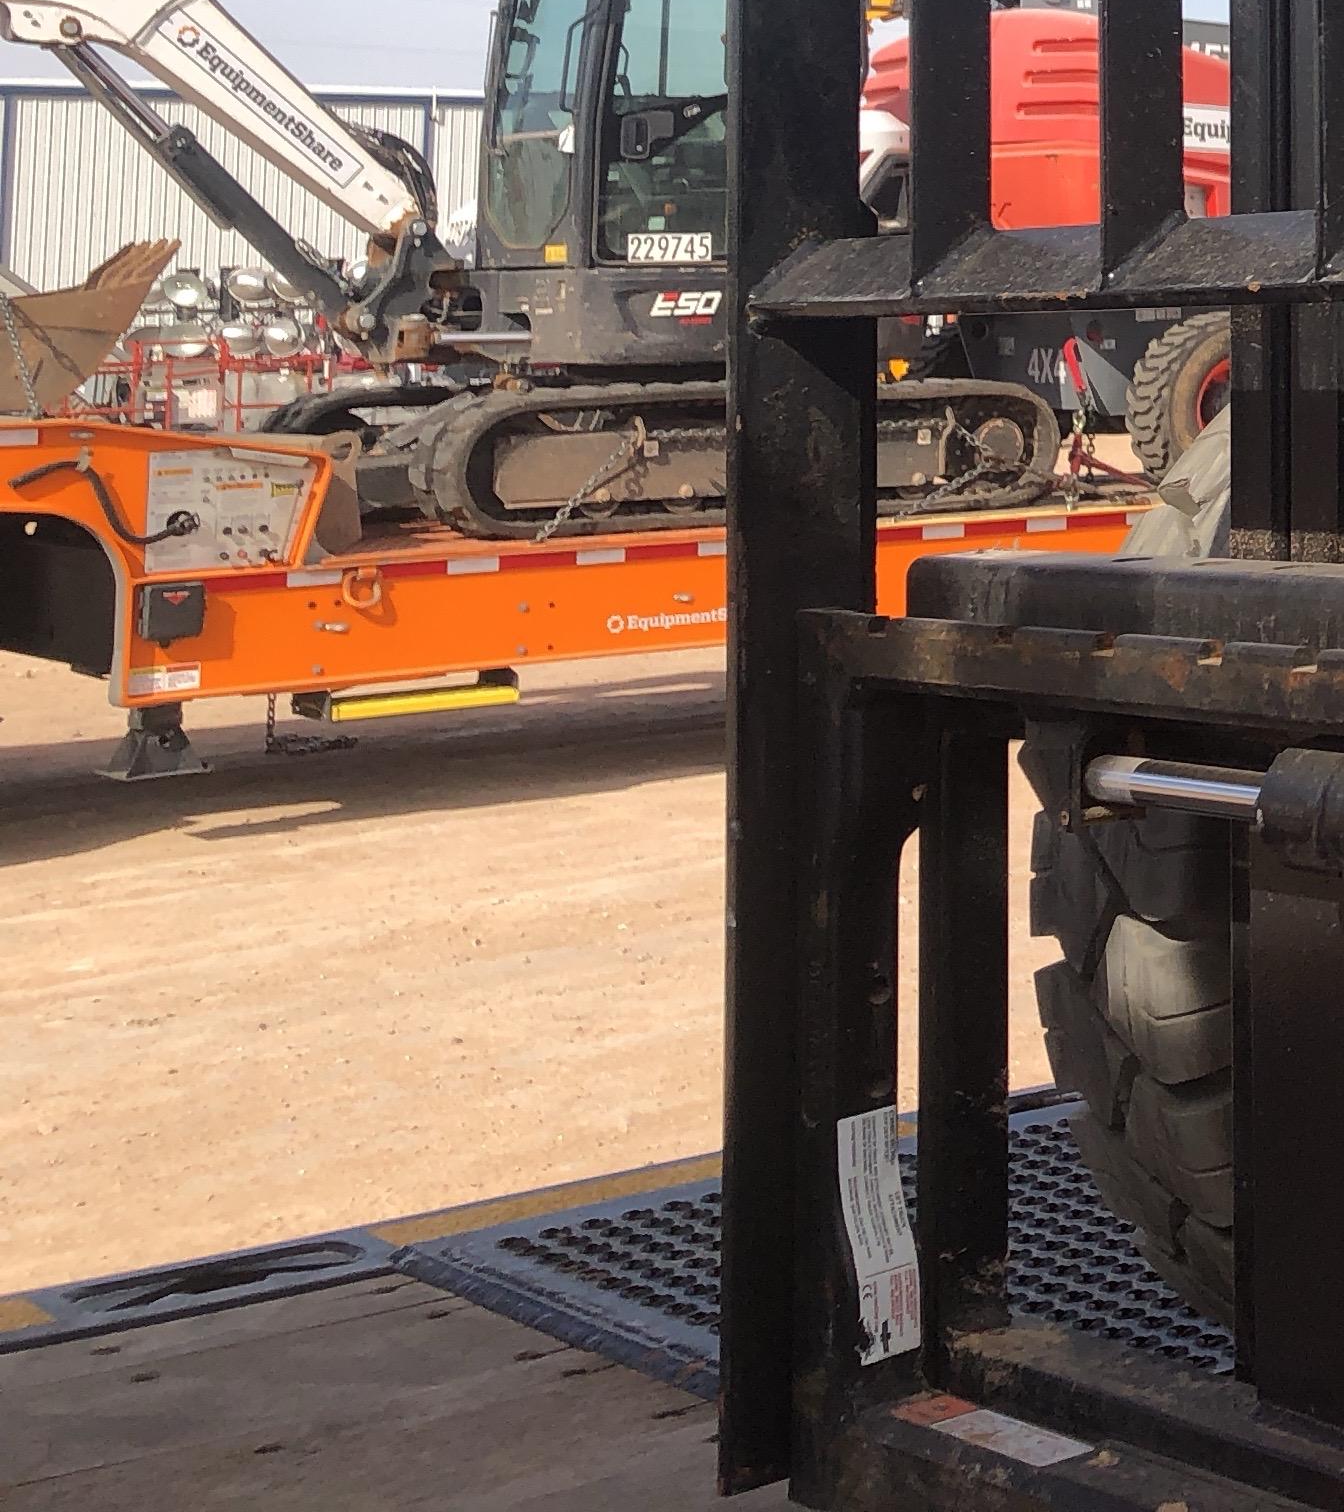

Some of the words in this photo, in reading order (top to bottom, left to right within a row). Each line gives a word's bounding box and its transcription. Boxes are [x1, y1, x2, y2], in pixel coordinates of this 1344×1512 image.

[196, 40, 345, 173] EquipmentShare
[630, 235, 710, 260] 229745
[650, 290, 723, 317] E50
[1027, 348, 1067, 384] 4X4
